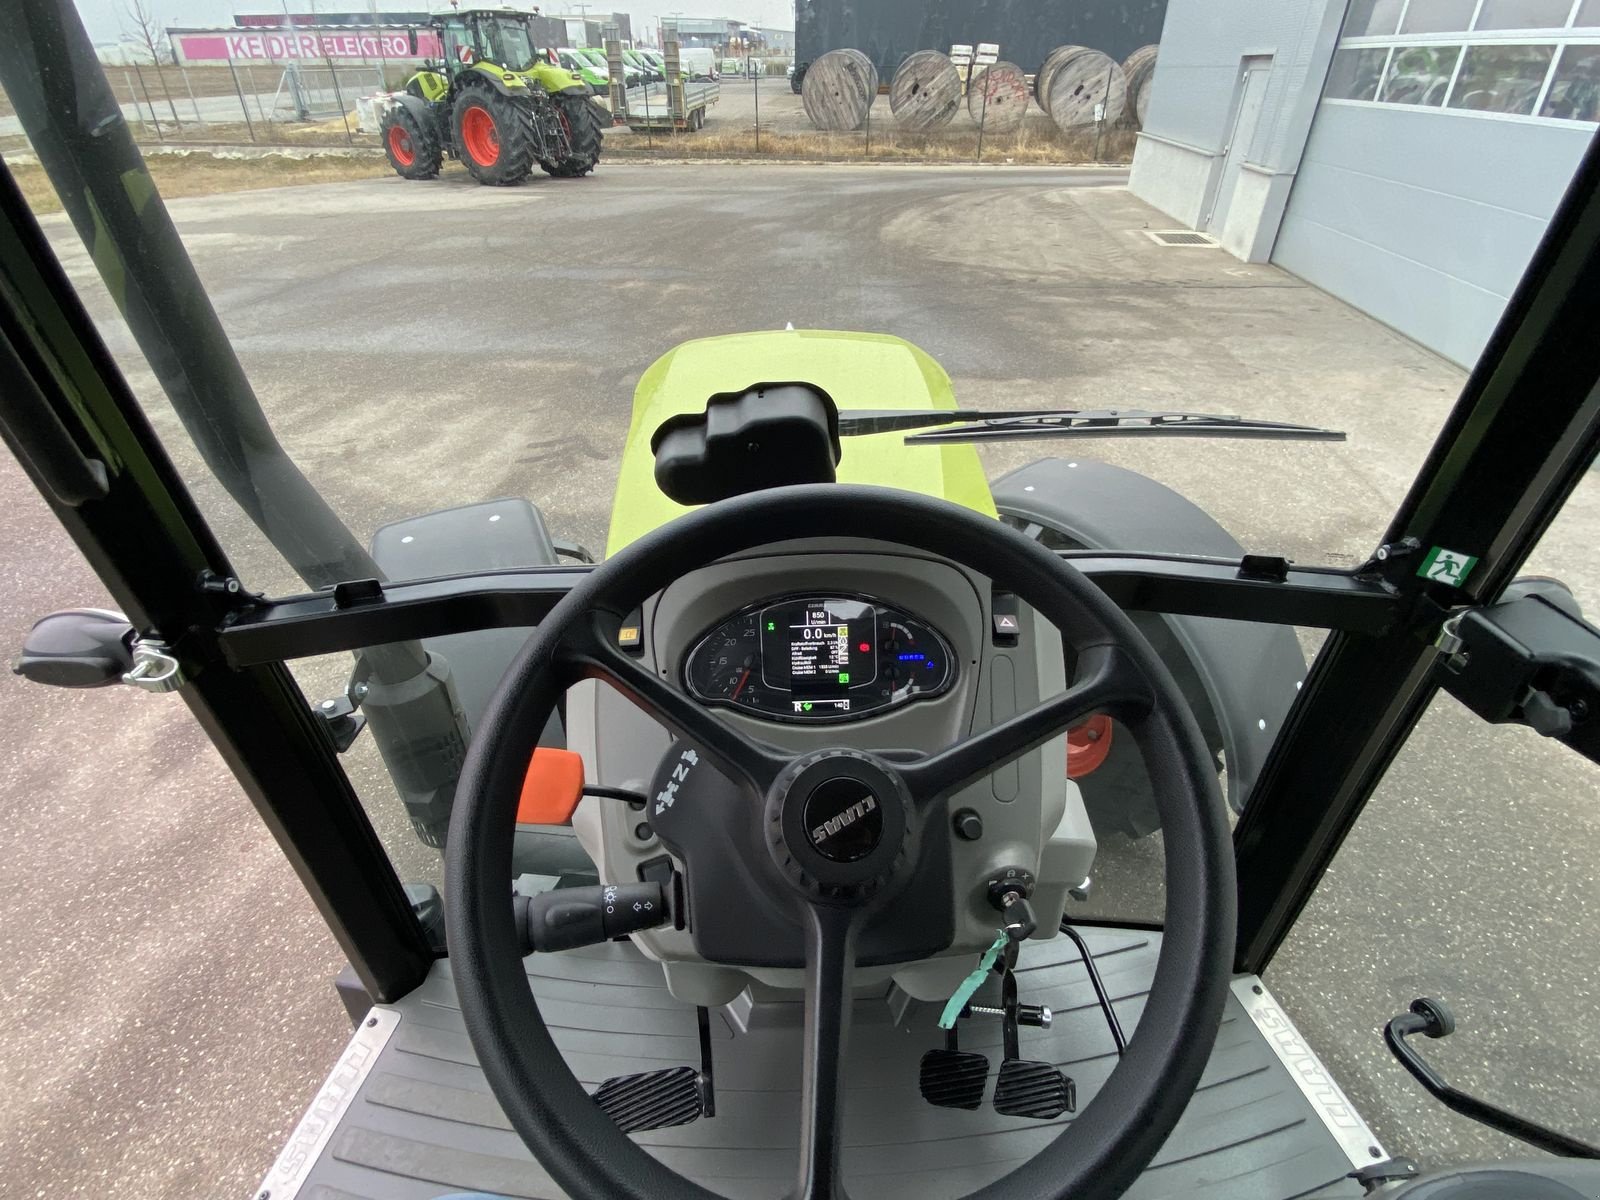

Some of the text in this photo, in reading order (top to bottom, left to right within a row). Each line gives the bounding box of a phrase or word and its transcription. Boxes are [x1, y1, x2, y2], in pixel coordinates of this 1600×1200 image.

[322, 37, 408, 56] ELEKTRO
[743, 629, 756, 637] 25
[803, 628, 822, 640] 0.0
[724, 638, 737, 646] 20
[719, 657, 728, 665] 15
[729, 677, 738, 685] 10
[748, 685, 755, 693] 5
[794, 702, 802, 712] R
[671, 763, 690, 782] N
[812, 795, 876, 844] CLAAS
